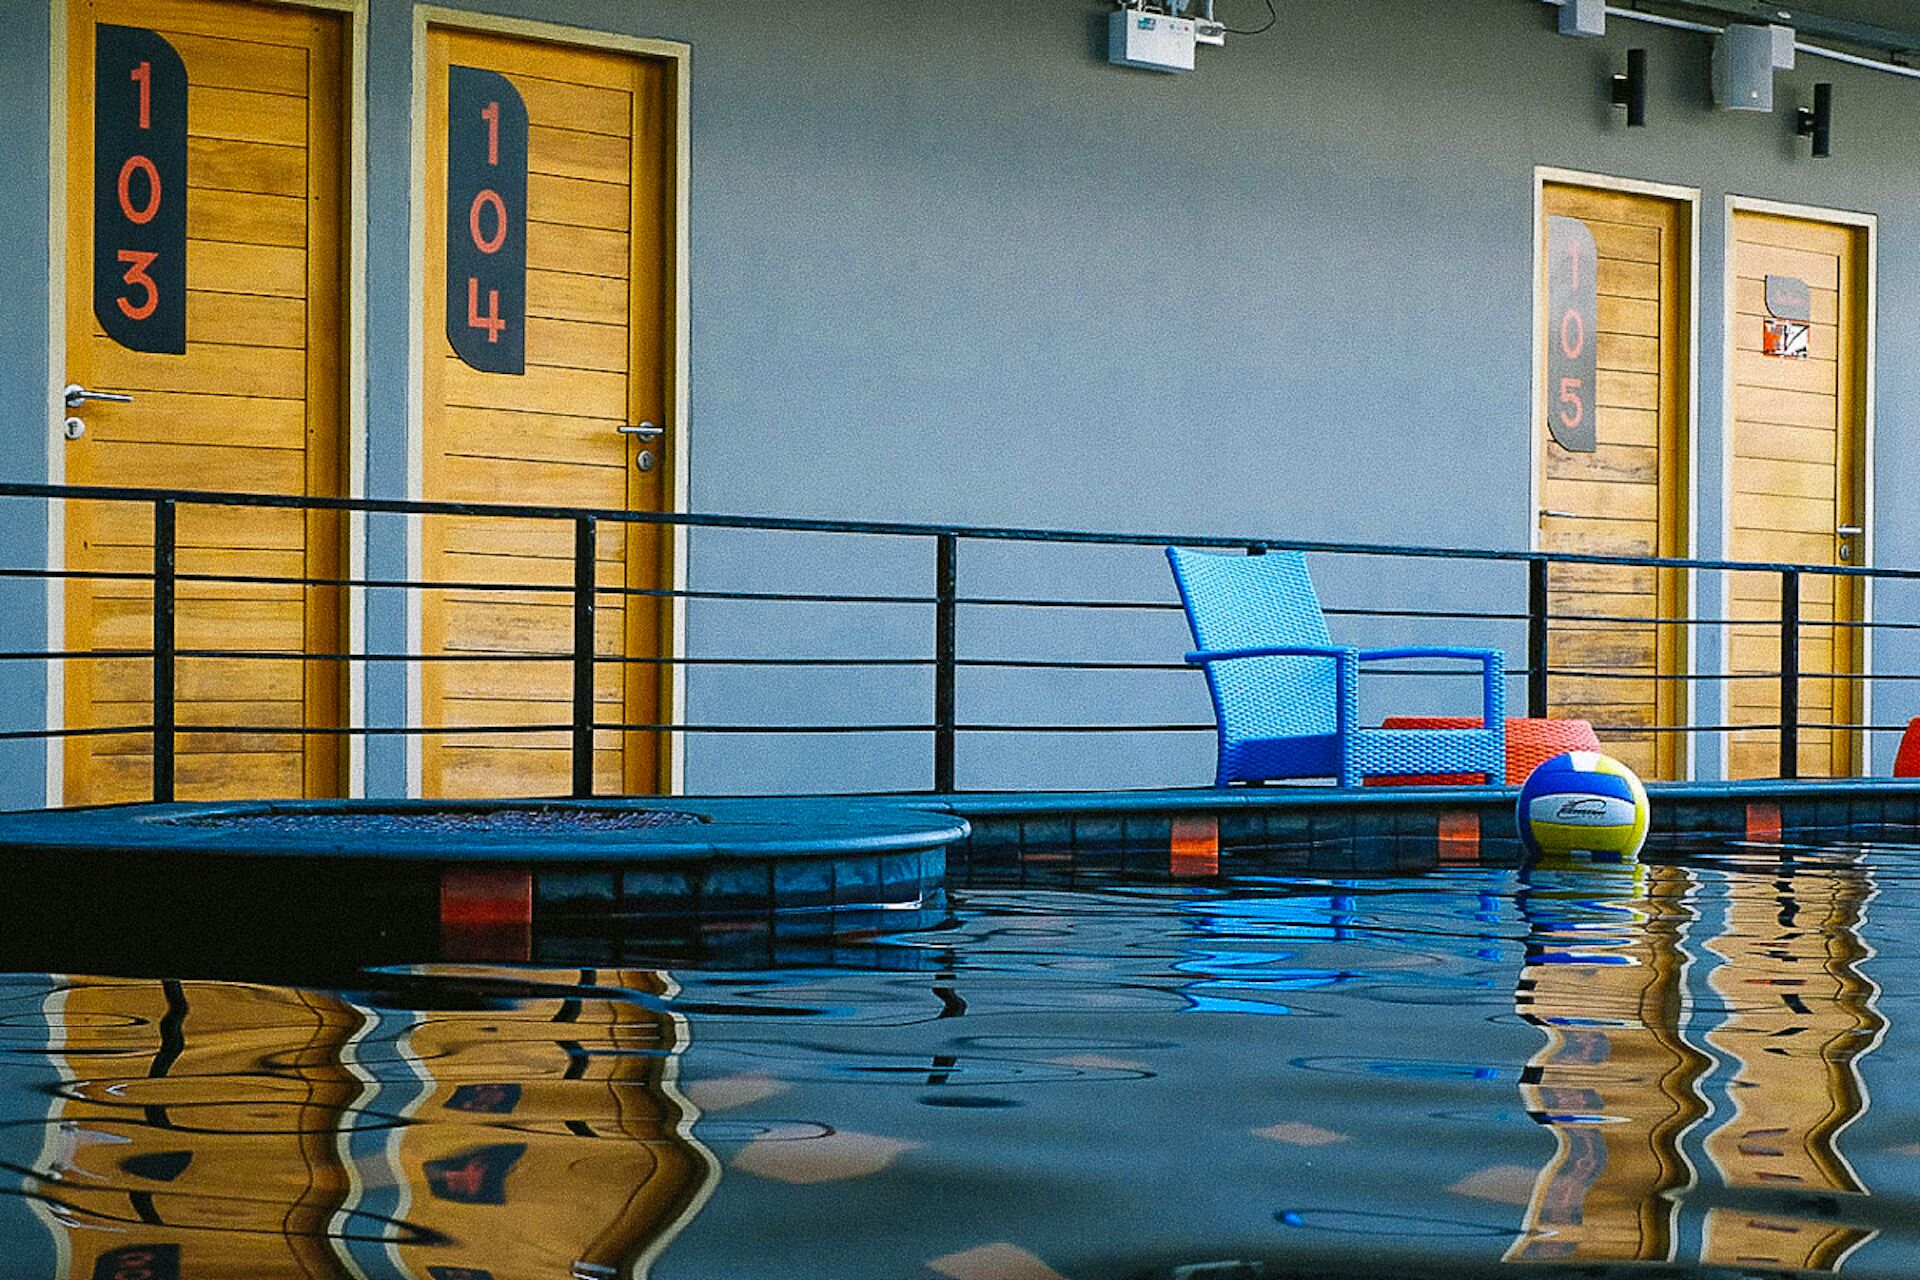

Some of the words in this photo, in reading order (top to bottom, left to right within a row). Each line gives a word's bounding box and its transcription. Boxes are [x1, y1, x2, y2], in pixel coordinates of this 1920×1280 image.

[116, 61, 162, 321] 103
[467, 101, 507, 344] 104
[1559, 243, 1585, 430] 105
